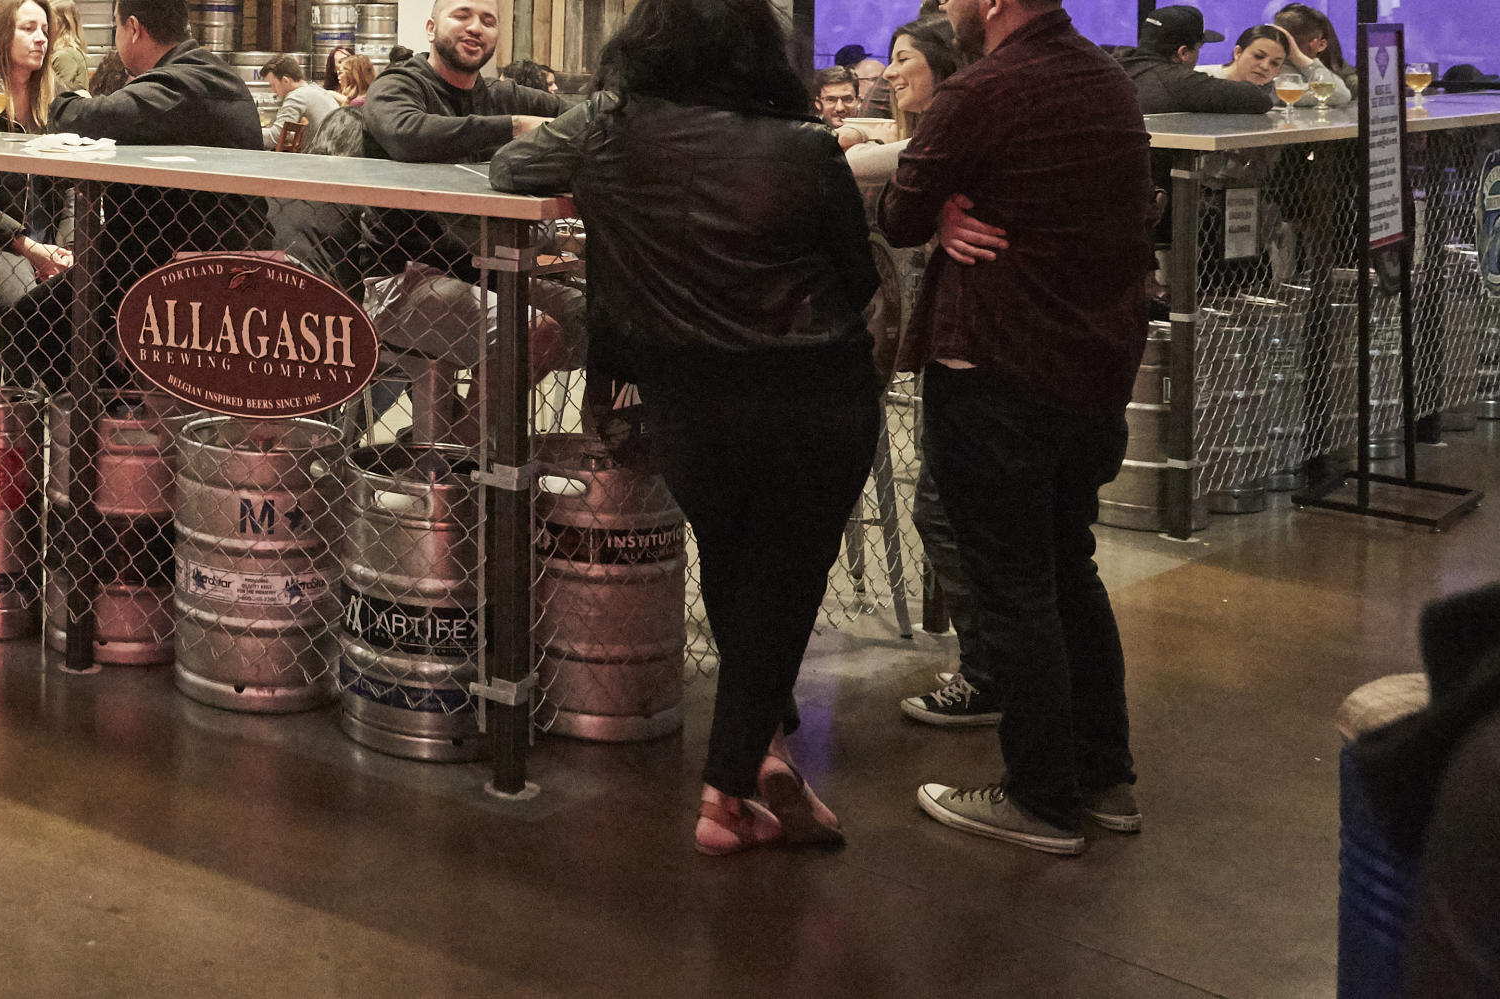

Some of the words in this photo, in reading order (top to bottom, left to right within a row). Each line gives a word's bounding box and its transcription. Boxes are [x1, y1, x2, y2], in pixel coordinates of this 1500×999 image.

[331, 4, 357, 24] GOO
[160, 263, 224, 287] PORTLAND
[266, 268, 307, 291] MAINE
[138, 294, 356, 368] ALLAGASH
[139, 348, 231, 371] BREWING
[248, 360, 353, 385] COMPANY
[168, 373, 202, 397] BELGIAN
[204, 389, 244, 408] INSPIRED
[246, 398, 274, 410] BEERS
[276, 398, 302, 410] SINCE
[240, 498, 275, 535] M
[607, 529, 682, 549] INSTITUTIO
